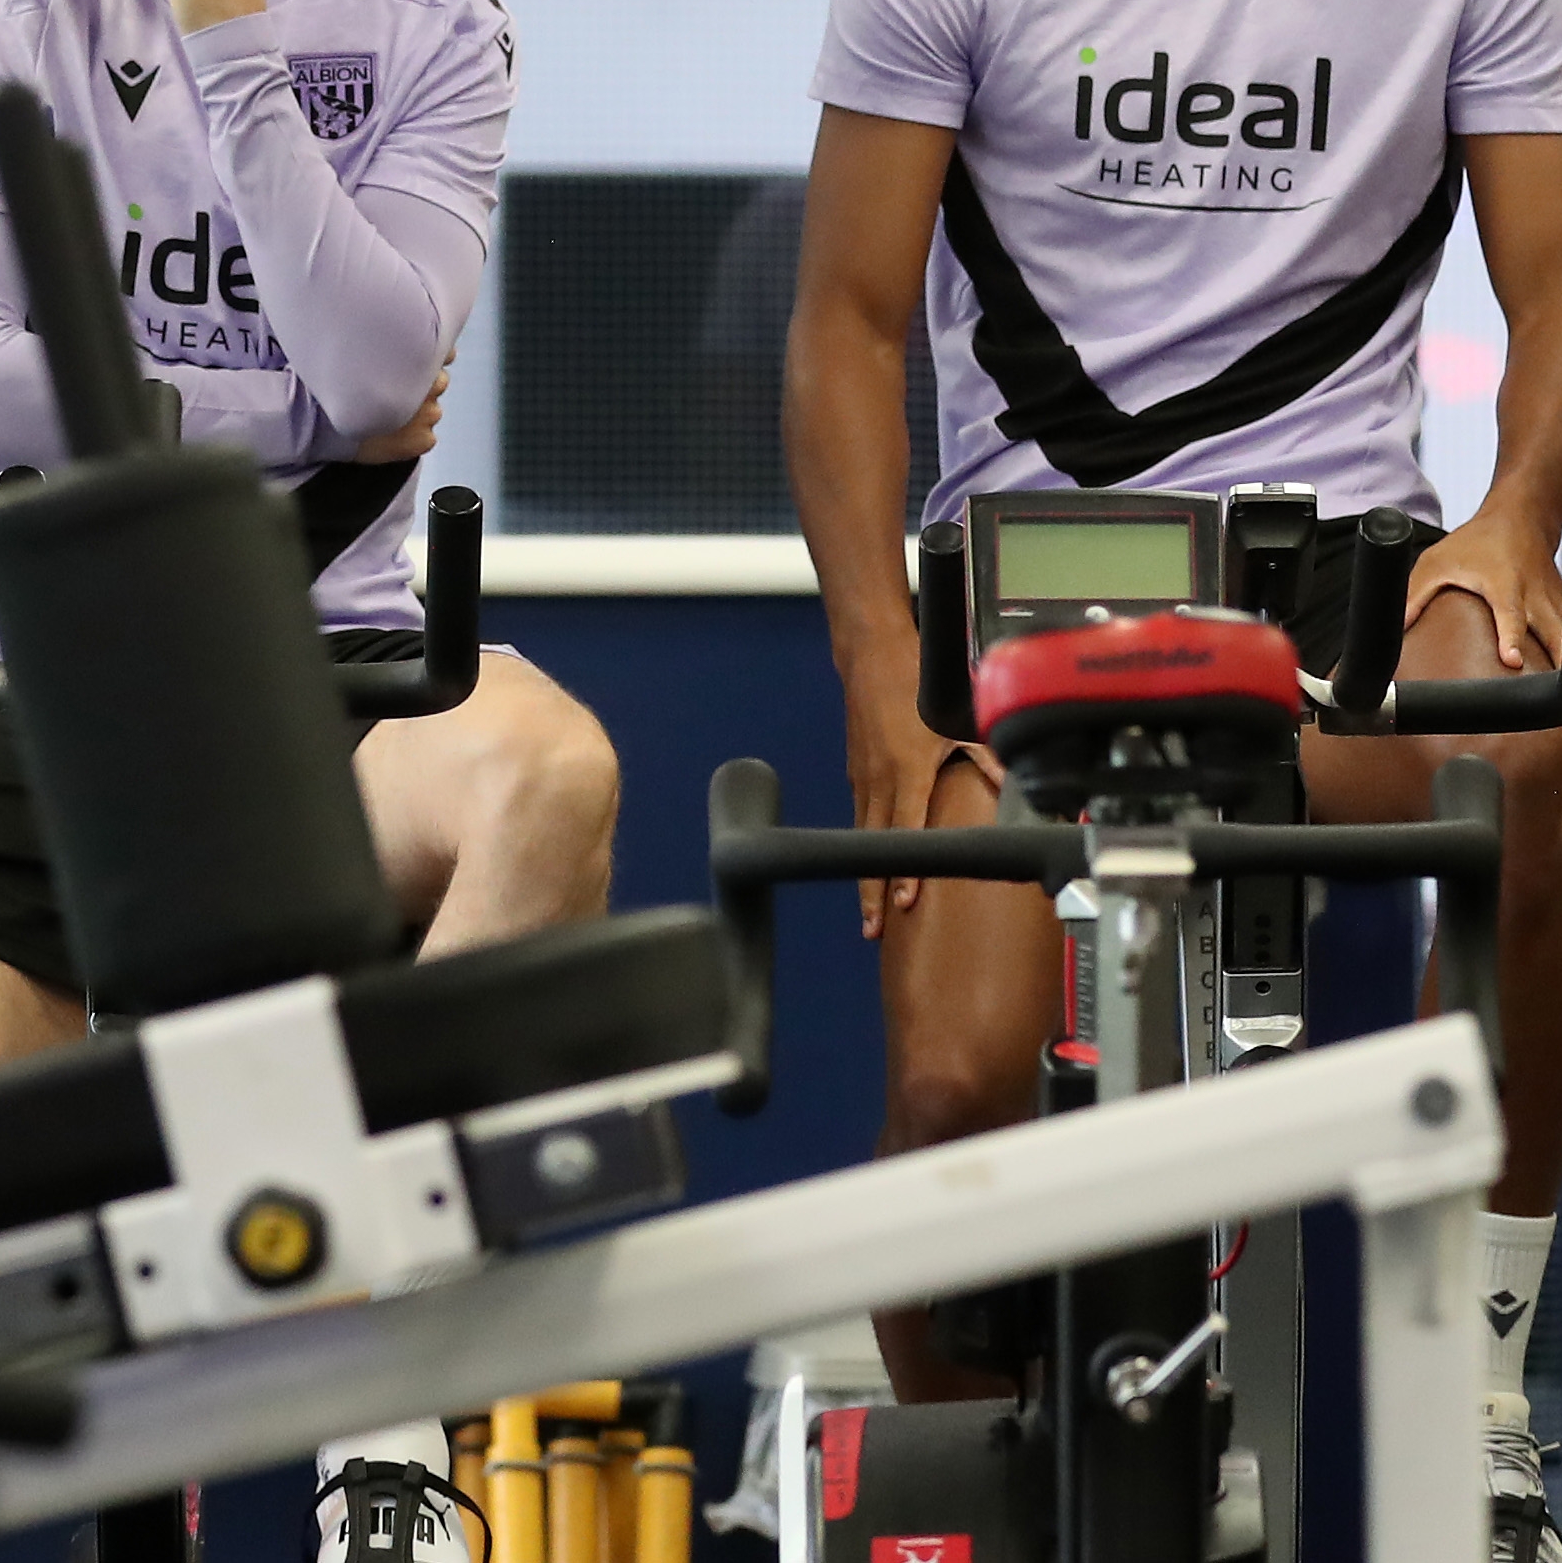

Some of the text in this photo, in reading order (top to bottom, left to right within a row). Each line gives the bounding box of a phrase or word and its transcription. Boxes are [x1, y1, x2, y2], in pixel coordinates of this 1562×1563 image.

[295, 66, 369, 84] ALBION
[1073, 47, 1333, 153] ideal
[1098, 159, 1295, 194] HEATING
[120, 202, 261, 315] ide
